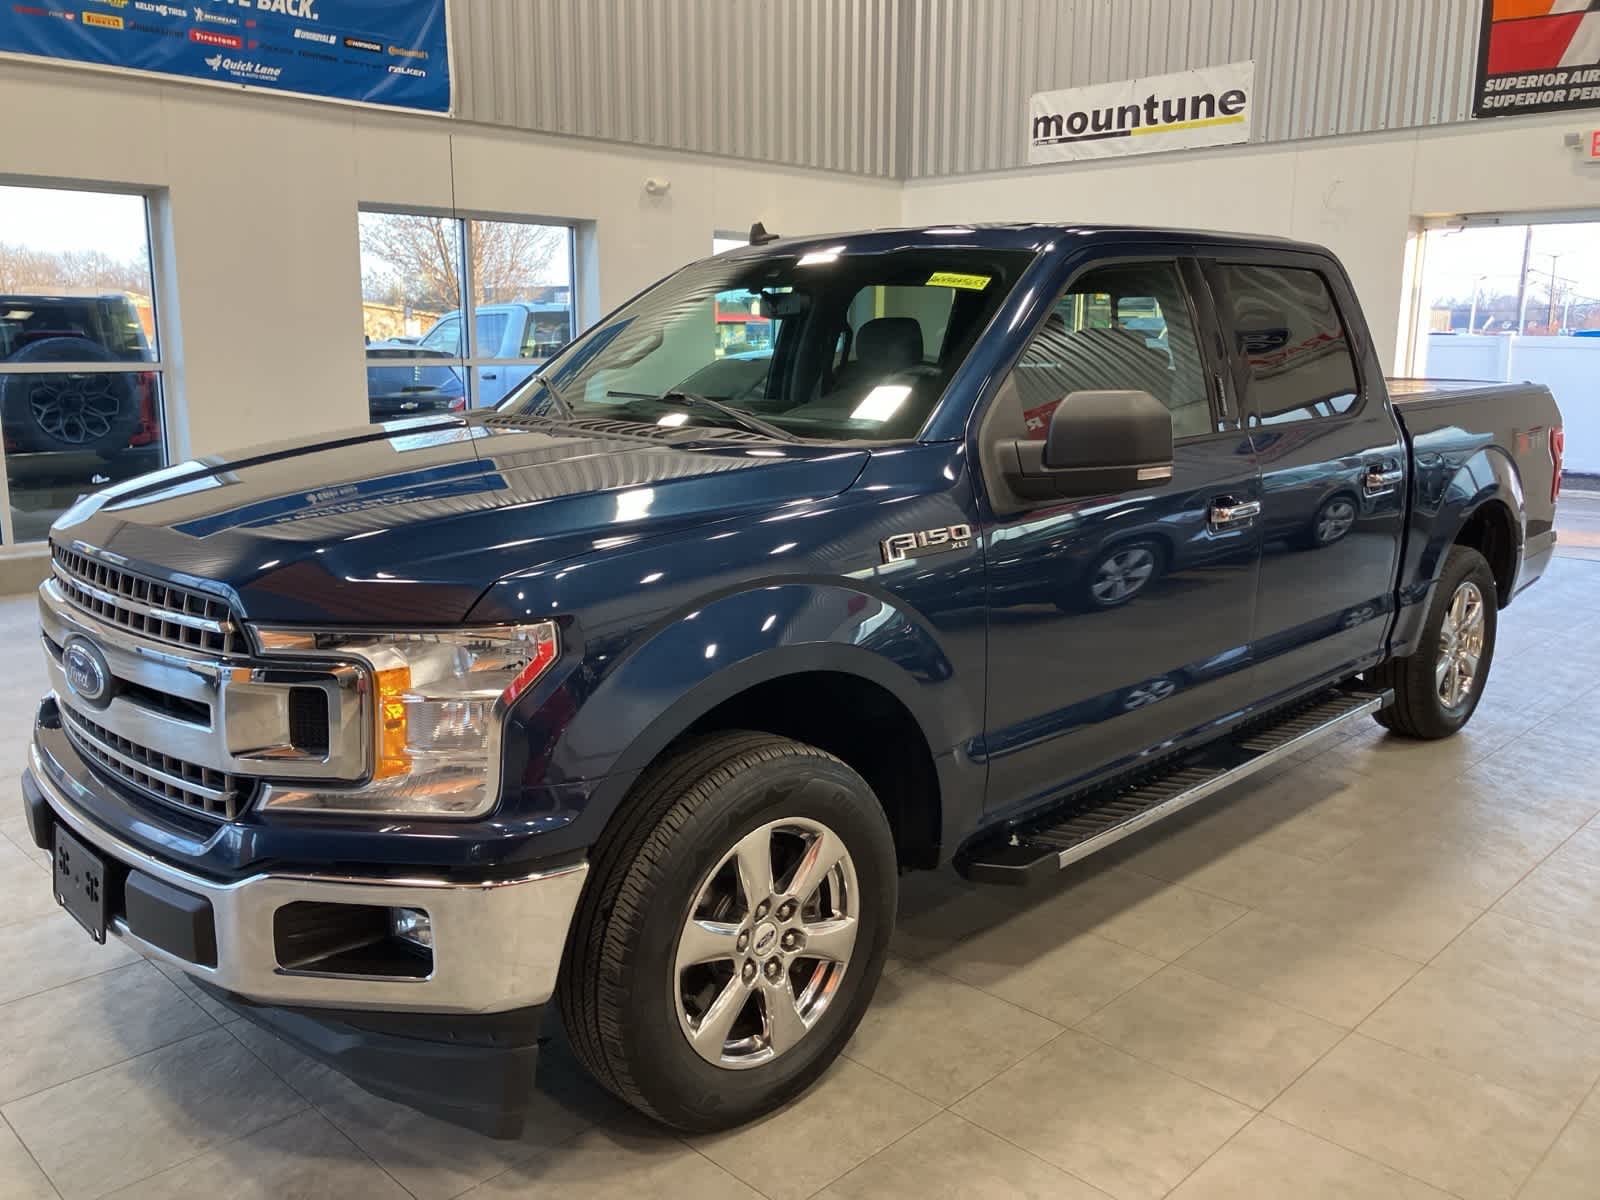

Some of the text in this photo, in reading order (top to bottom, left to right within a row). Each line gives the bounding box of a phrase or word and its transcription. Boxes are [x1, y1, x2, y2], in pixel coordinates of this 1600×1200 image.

[222, 58, 282, 76] Quick Lane
[1484, 72, 1568, 92] SUPERIOR
[1482, 89, 1567, 109] SUPERIOR
[1033, 89, 1247, 139] mountune
[951, 540, 969, 549] XLT
